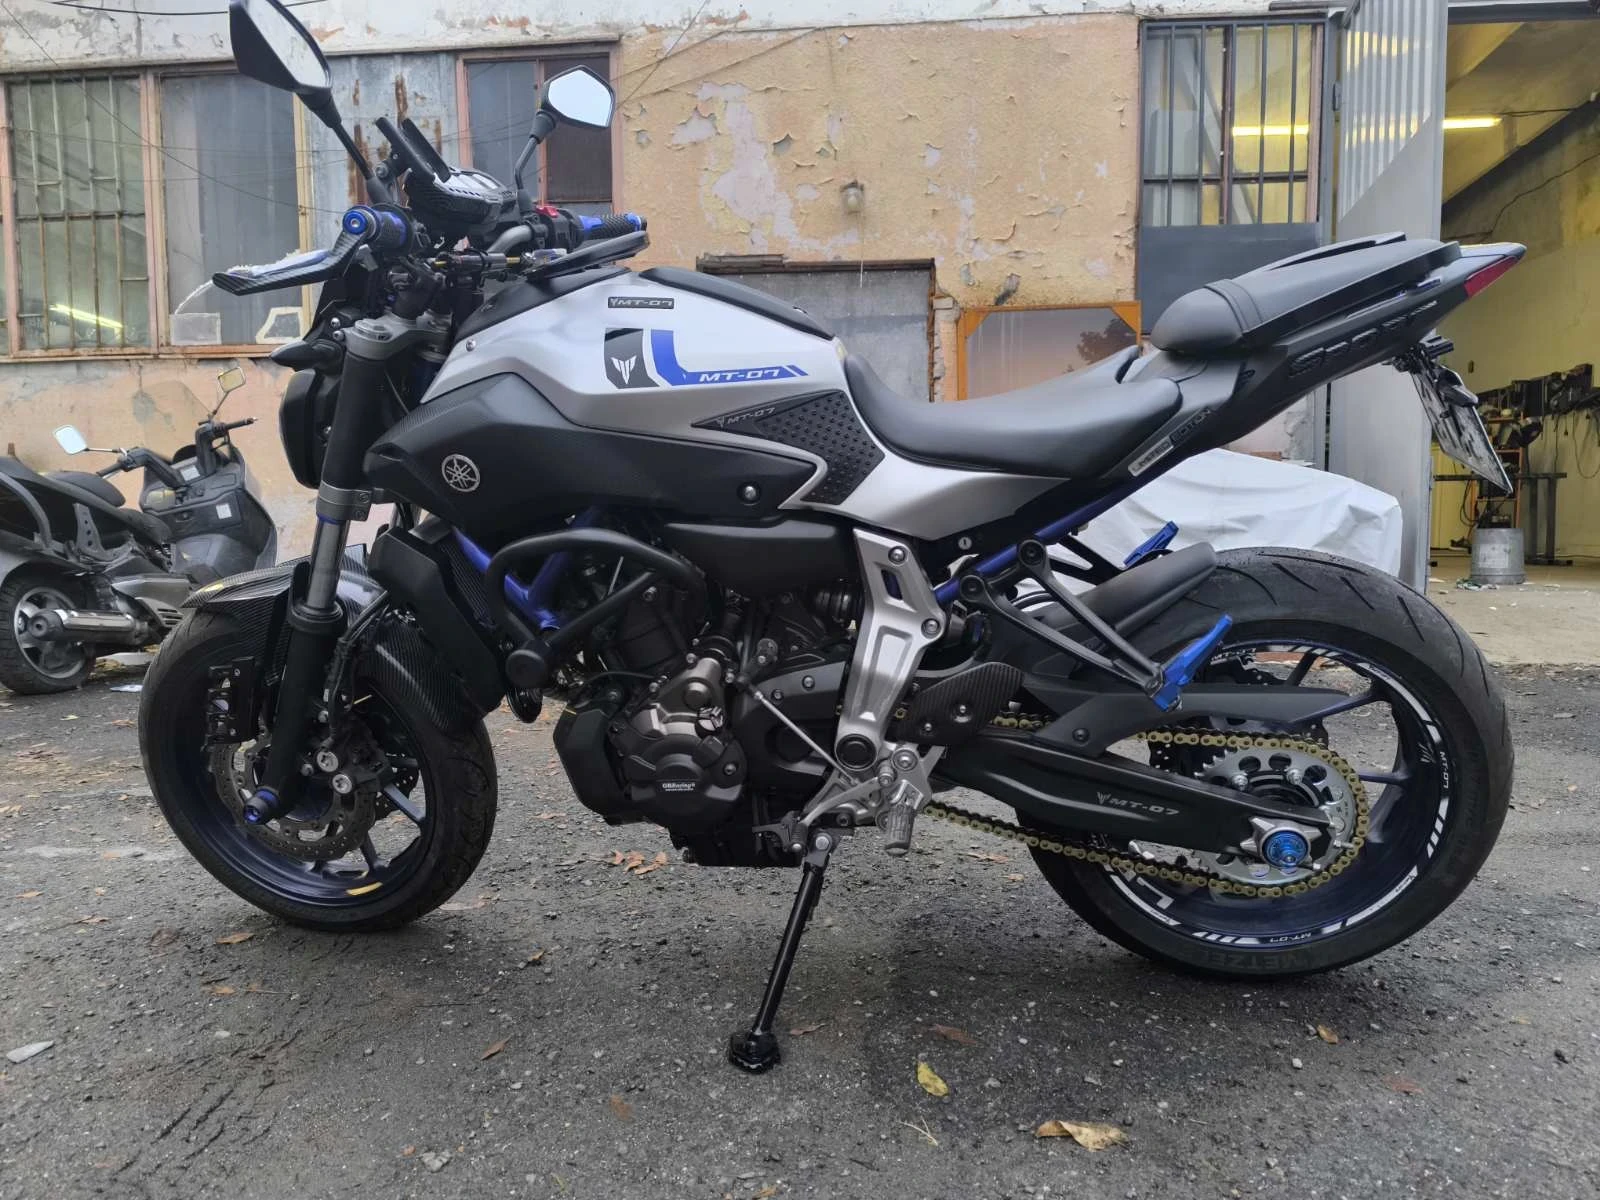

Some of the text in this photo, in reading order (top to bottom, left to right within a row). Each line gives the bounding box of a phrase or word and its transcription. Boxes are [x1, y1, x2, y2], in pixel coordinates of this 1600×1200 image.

[616, 298, 674, 307] MT-07
[700, 369, 780, 383] MT-07
[727, 407, 776, 424] MT-07
[1440, 751, 1449, 789] MT-07
[1108, 797, 1180, 815] MT-07
[1269, 932, 1312, 943] MT-07
